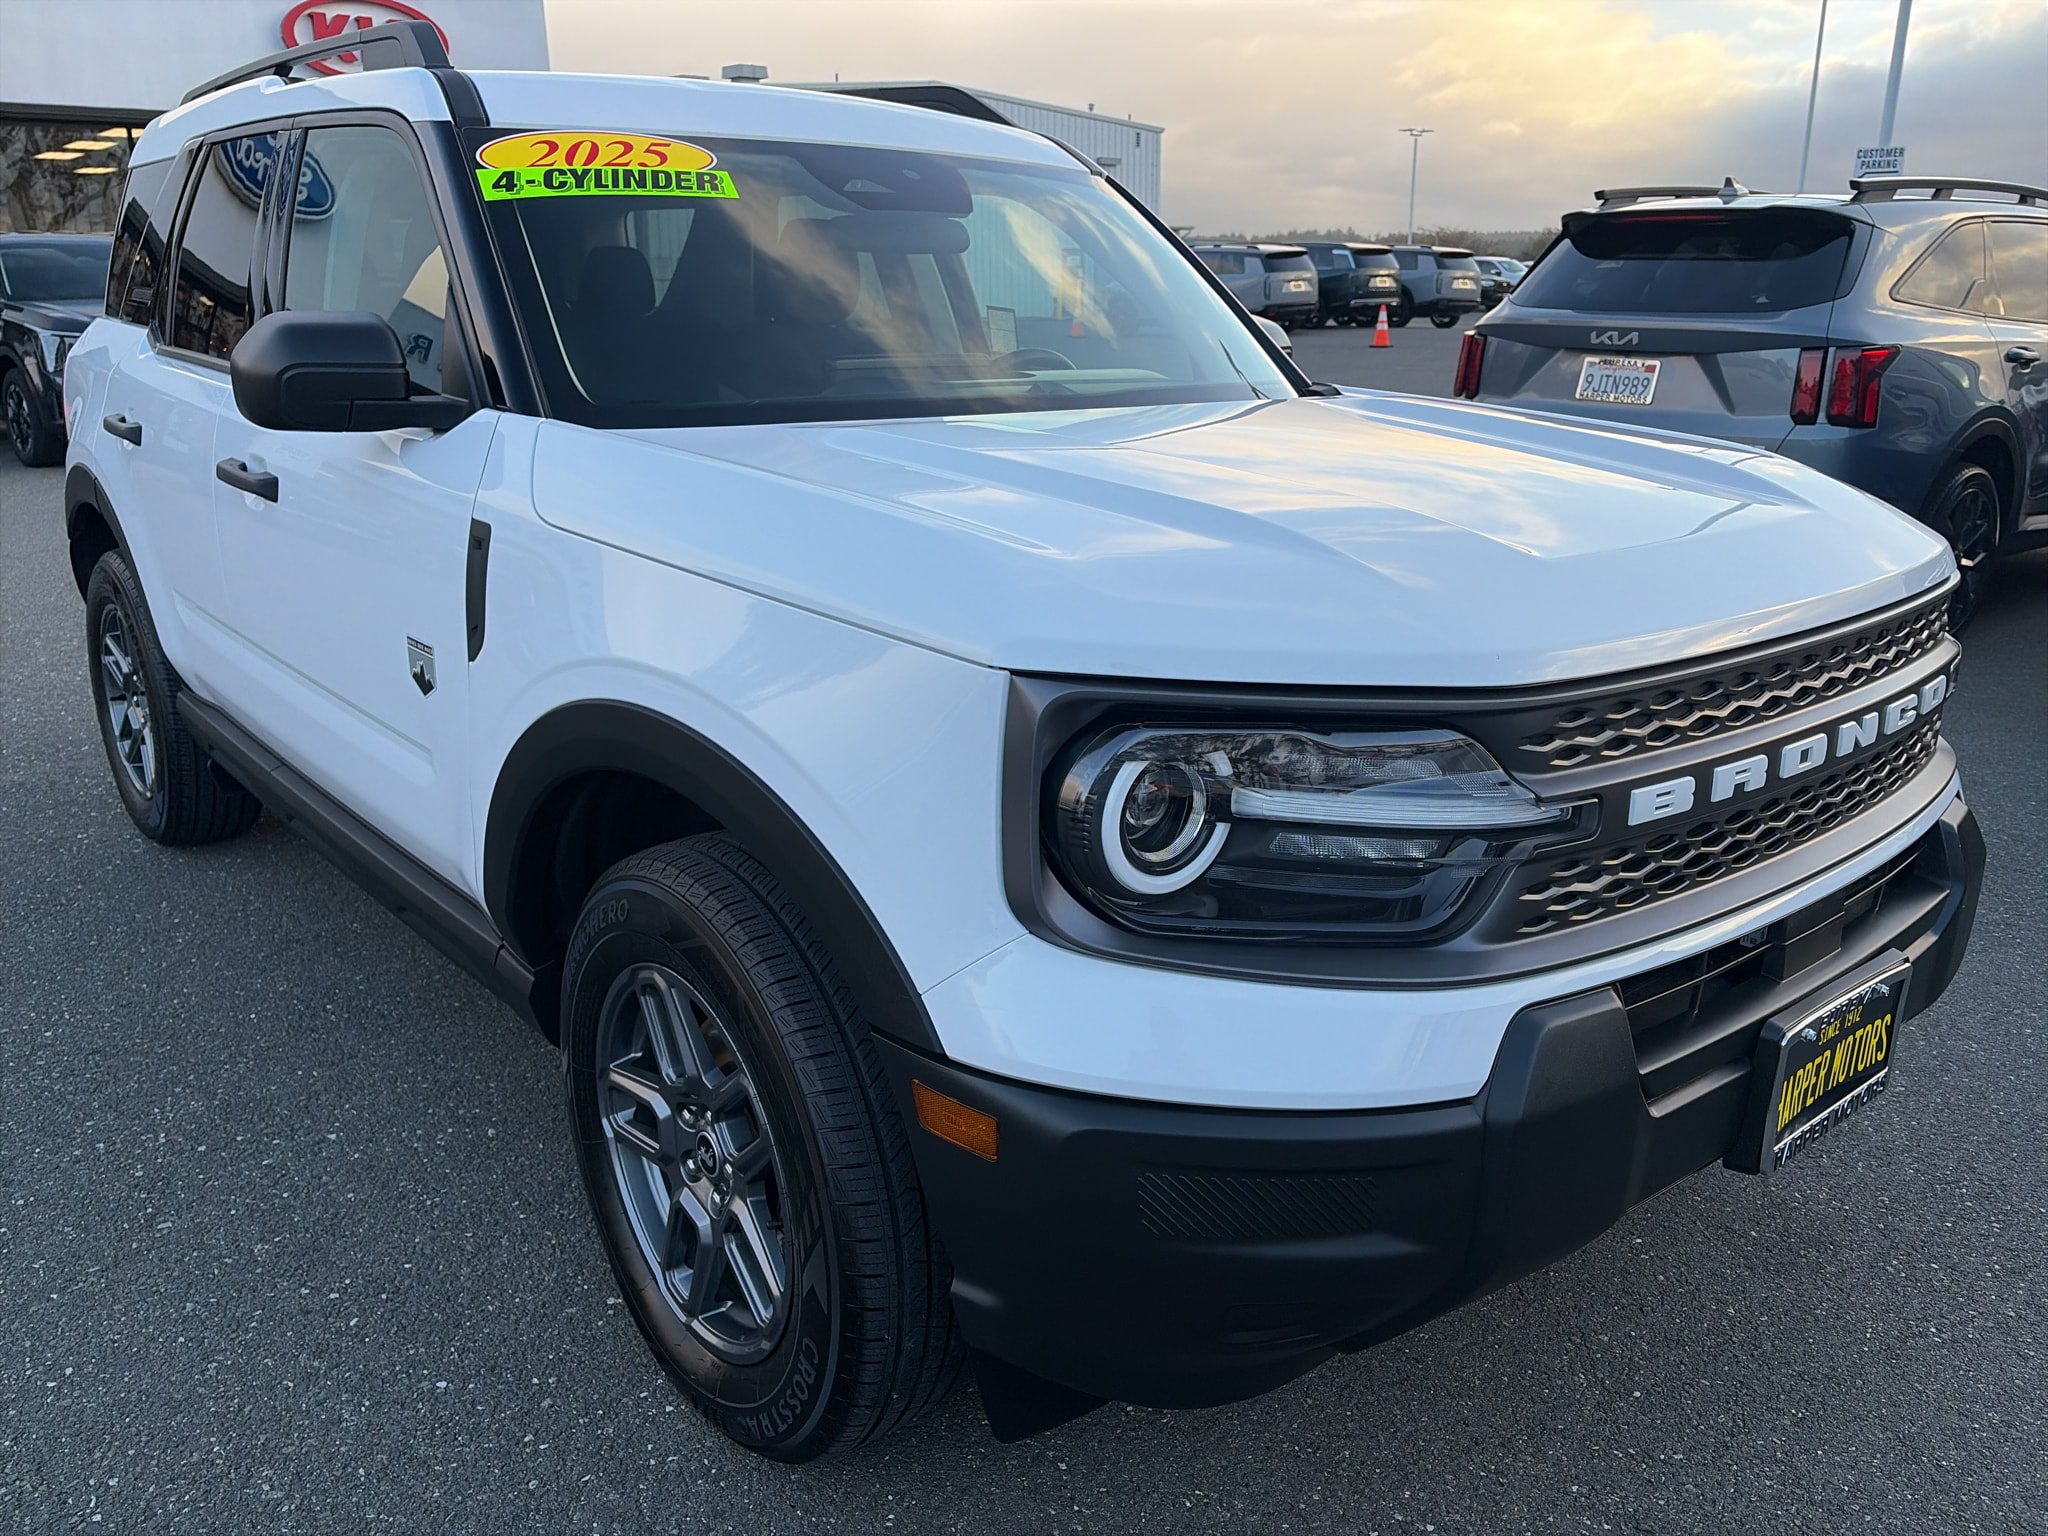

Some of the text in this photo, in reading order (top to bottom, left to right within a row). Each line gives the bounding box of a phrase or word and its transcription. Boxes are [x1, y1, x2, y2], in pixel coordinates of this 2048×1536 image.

[527, 139, 672, 168] 2025
[1857, 148, 1904, 159] CUSTOMER
[1860, 159, 1898, 170] PARKING
[491, 167, 726, 195] 4-CYLINDER
[1590, 330, 1640, 346] KIA
[1579, 391, 1648, 404] HARPER MOTORS
[1583, 374, 1650, 396] 9JIN989
[1628, 675, 1948, 826] BRONCO
[1818, 1005, 1863, 1046] SINCE 1912
[1828, 1013, 1892, 1090] MOTORS
